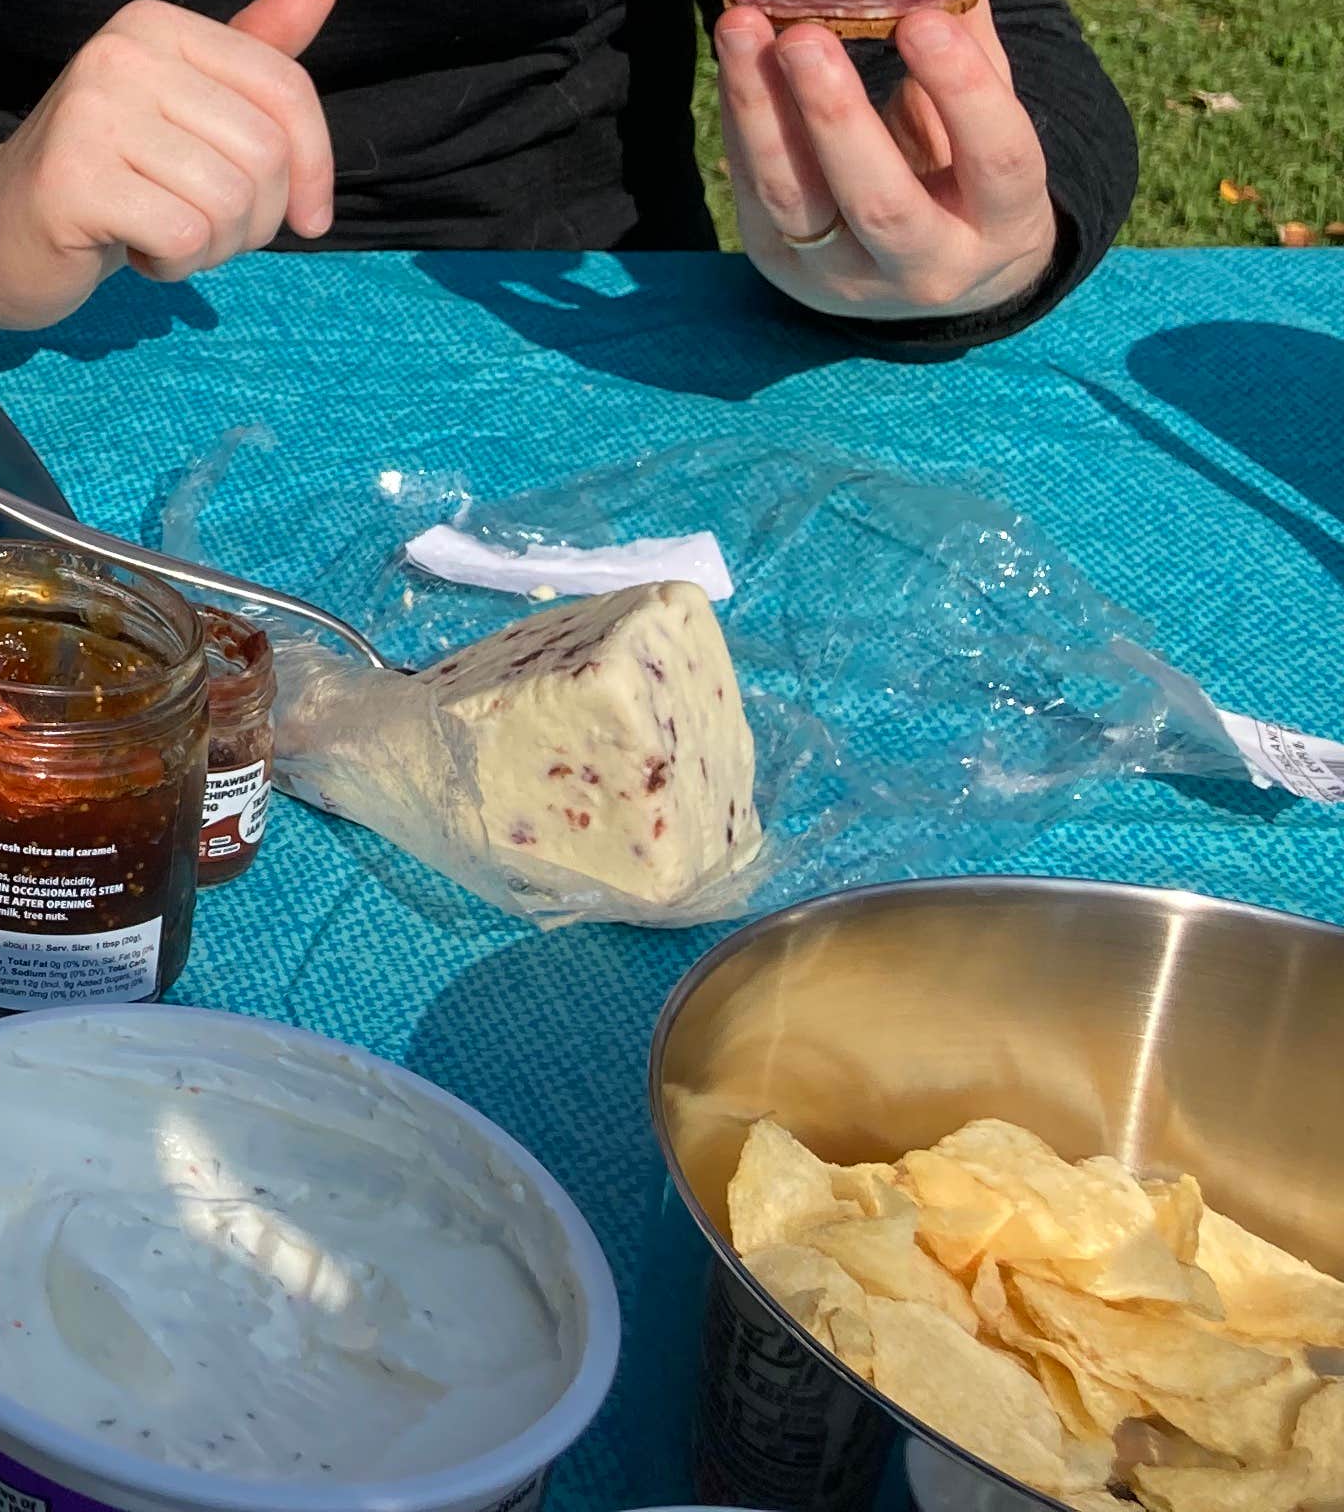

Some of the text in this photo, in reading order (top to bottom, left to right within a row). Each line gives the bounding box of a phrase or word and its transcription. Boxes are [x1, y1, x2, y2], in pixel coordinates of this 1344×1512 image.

[23, 844, 53, 857] citrus
[54, 847, 74, 857] and
[76, 843, 118, 857] caramel.
[13, 873, 38, 885] citric
[39, 876, 59, 886] acid
[61, 876, 96, 888] (acidity
[12, 885, 79, 898] OCCASIONAL
[80, 887, 97, 897] FIG
[99, 883, 124, 896] STEM
[12, 896, 44, 909] AFTER
[46, 898, 95, 909] OPENING.
[23, 910, 43, 920] tree
[45, 912, 69, 921] nuts.
[3, 939, 29, 951] about
[102, 939, 121, 950] tbsp
[7, 957, 31, 967] Total
[33, 958, 48, 968] Fat
[11, 966, 47, 978] Sodium
